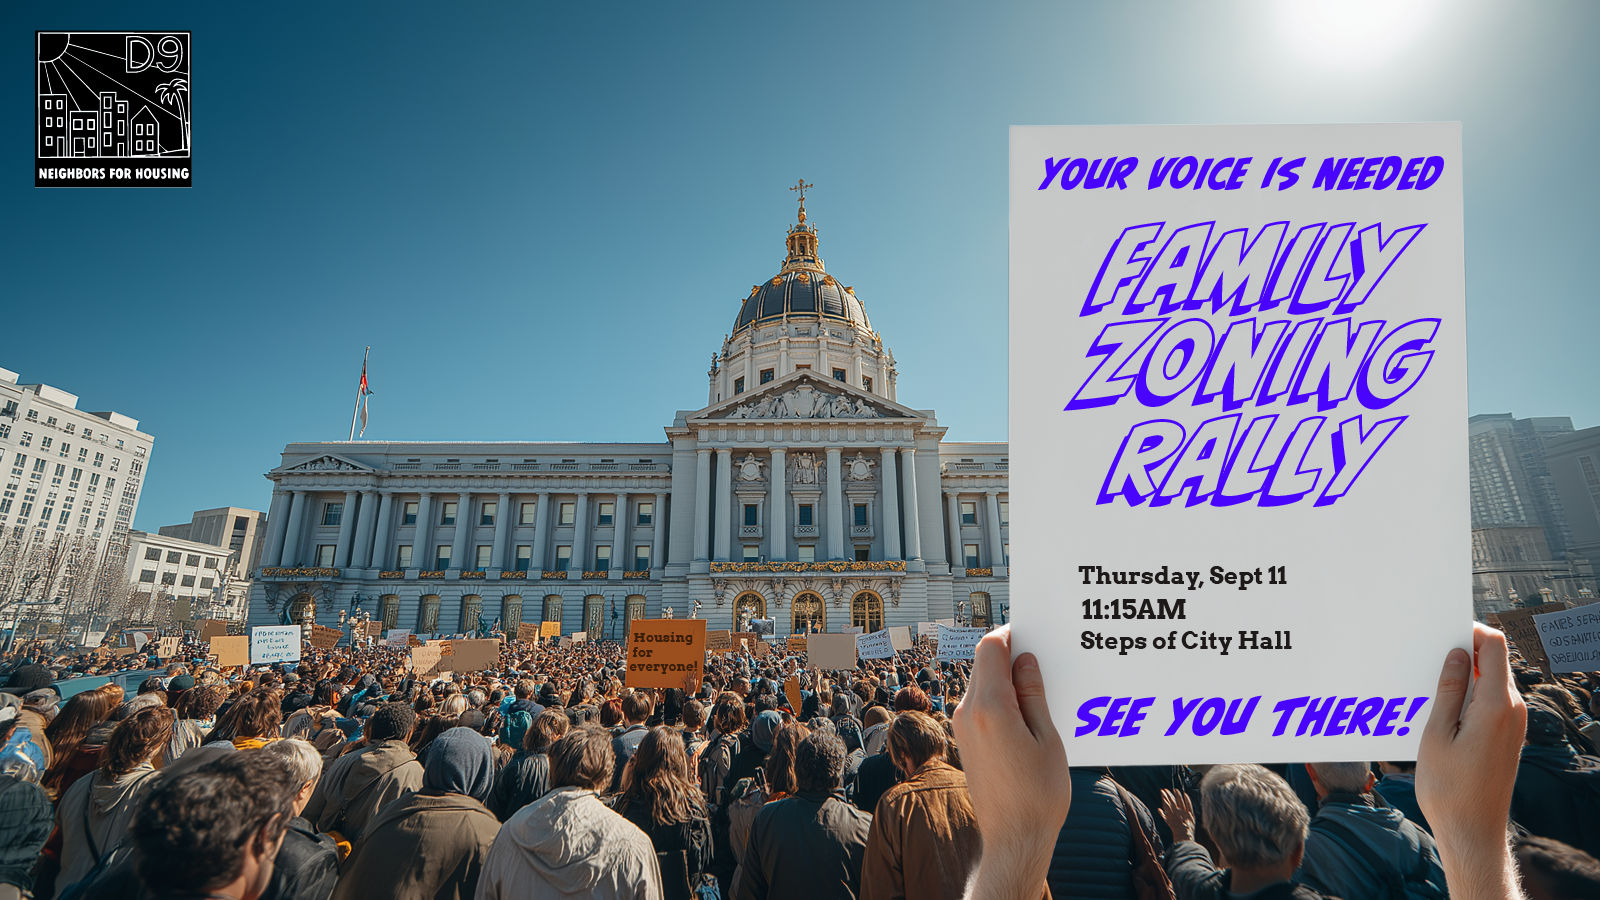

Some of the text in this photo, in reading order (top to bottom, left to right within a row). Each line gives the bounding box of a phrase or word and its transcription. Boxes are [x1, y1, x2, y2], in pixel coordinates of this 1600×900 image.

[1038, 156, 1445, 191] YOUR VOICE IS NEEDED
[1079, 220, 1429, 318] FAMILY
[1063, 316, 1443, 413] ZONING
[1096, 412, 1410, 508] RALLY
[1078, 565, 1288, 591] Thursday, Sept 11
[1082, 598, 1187, 620] 11:15AM
[634, 632, 693, 646] Housing
[1080, 630, 1292, 656] Steps of City Hall
[632, 647, 653, 658] for
[629, 660, 698, 674] everyone!
[1075, 695, 1430, 738] SEE YOU THERE!
